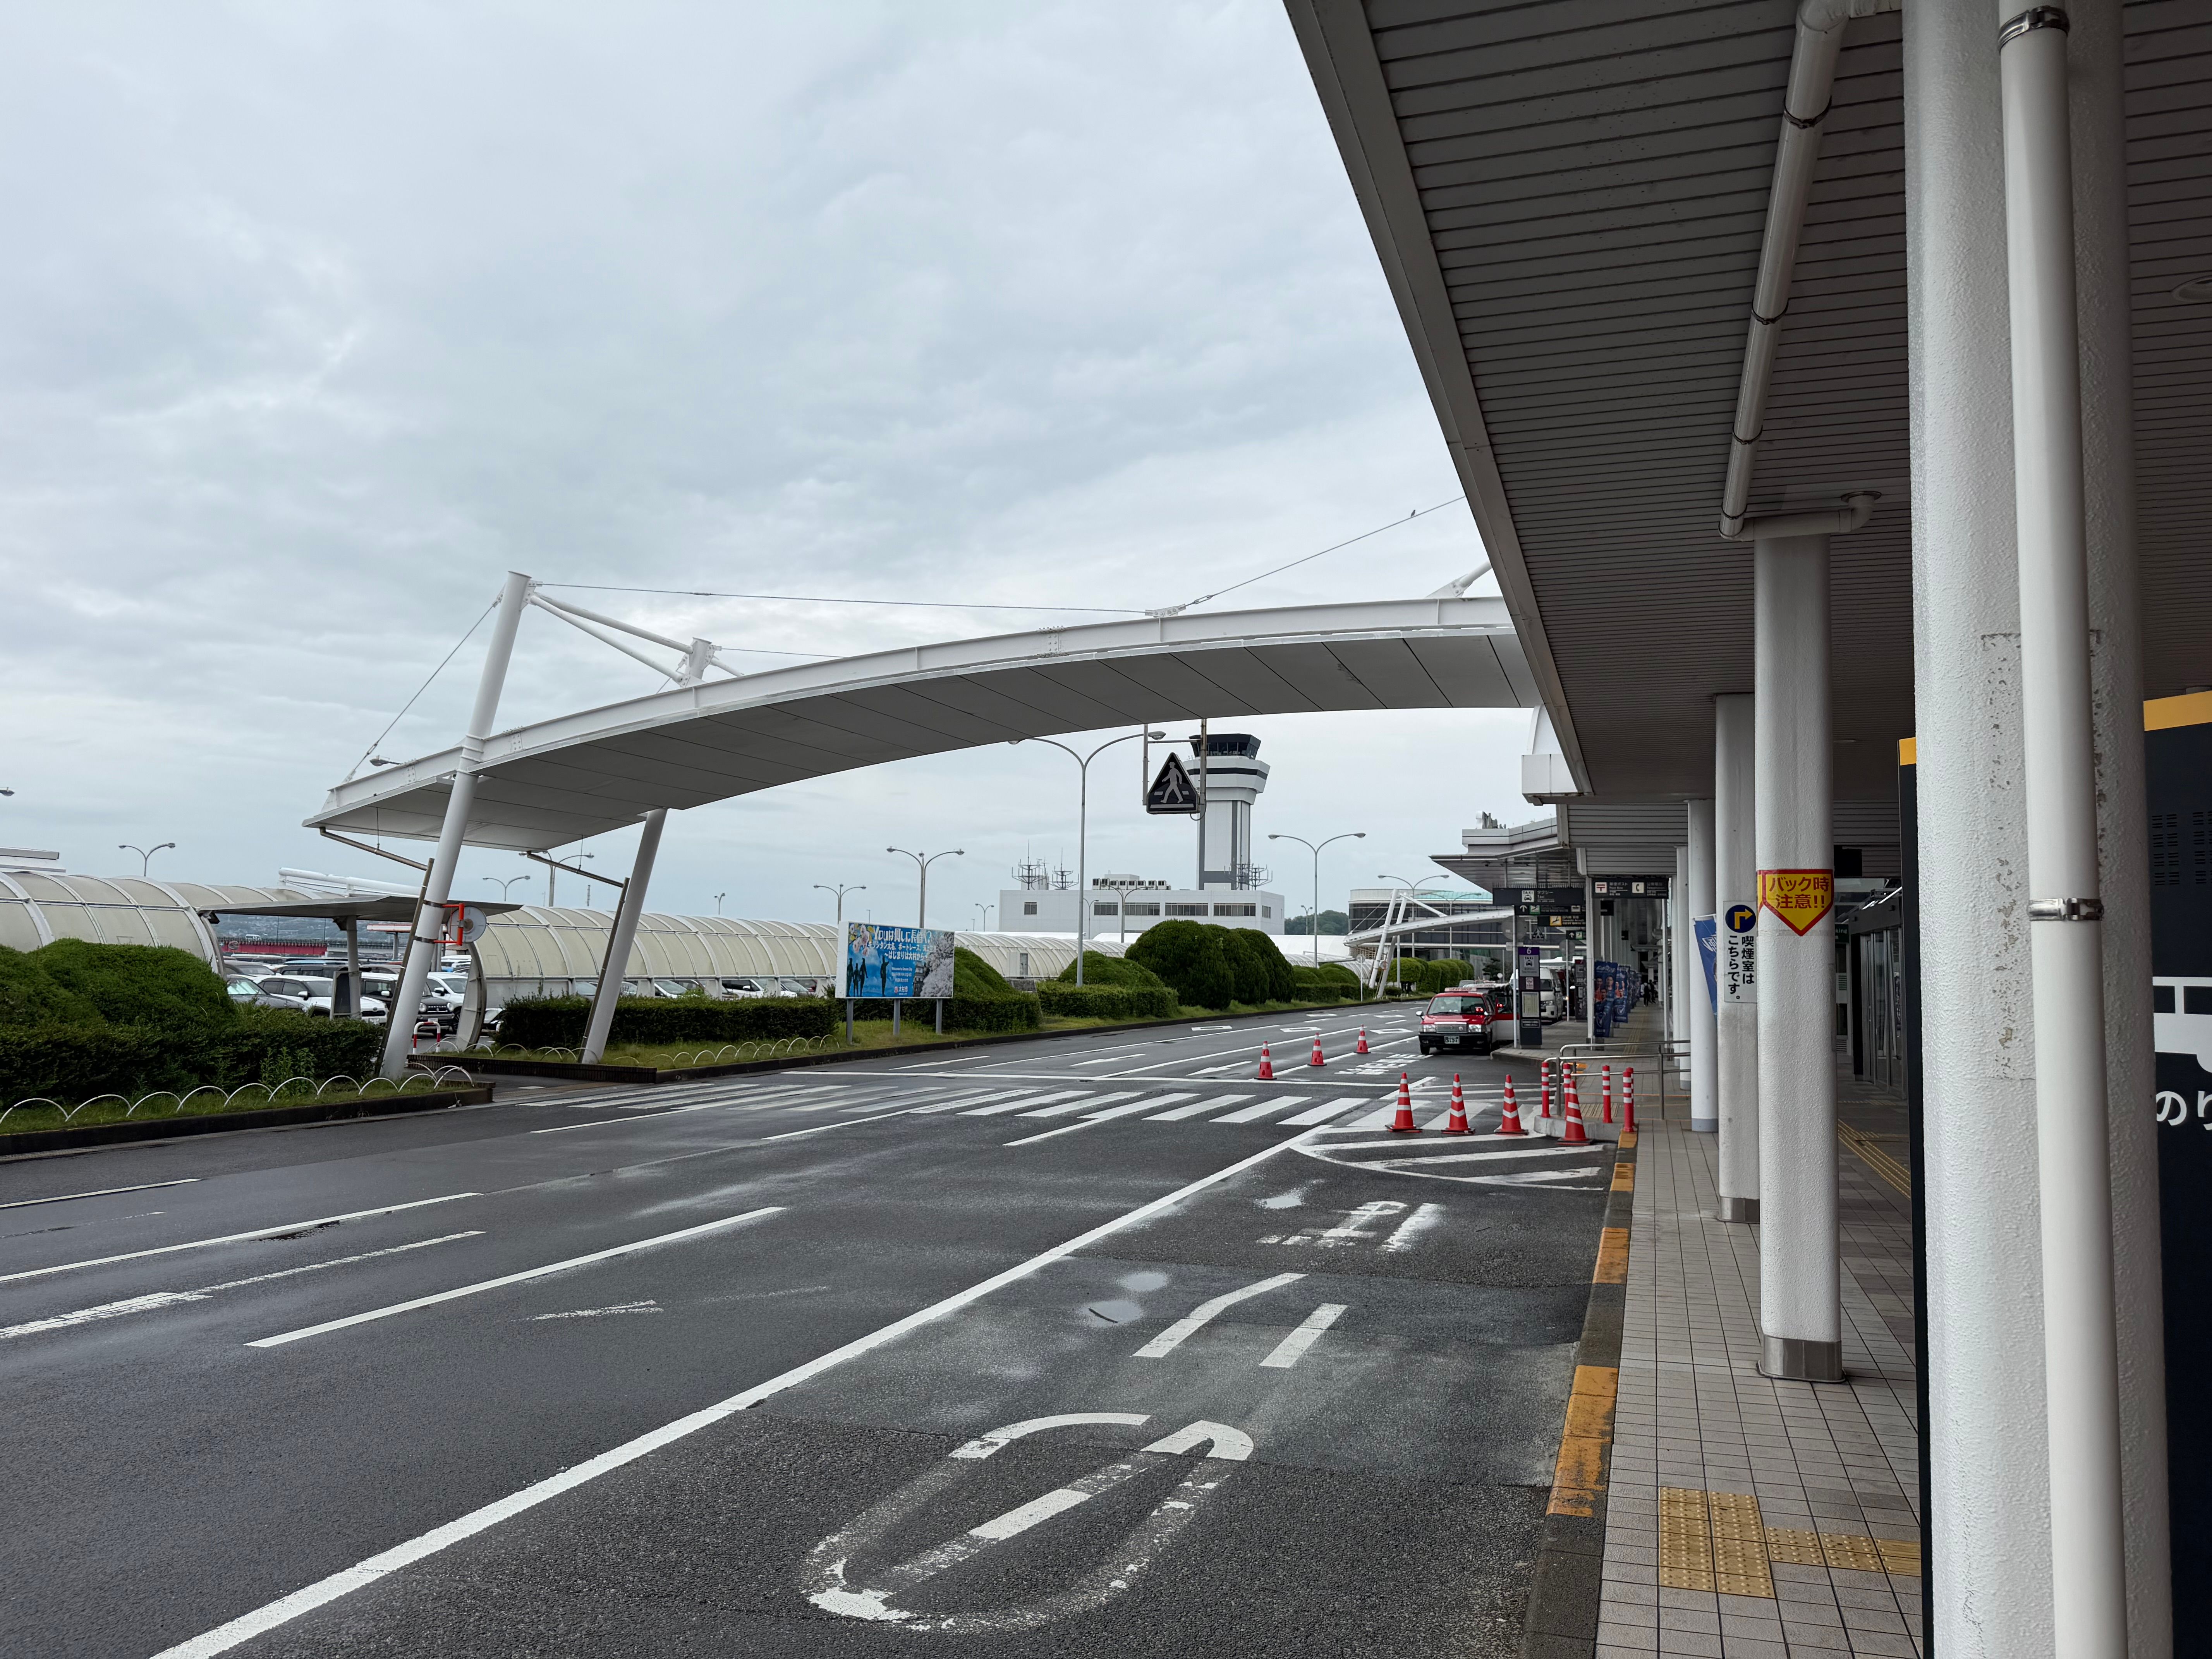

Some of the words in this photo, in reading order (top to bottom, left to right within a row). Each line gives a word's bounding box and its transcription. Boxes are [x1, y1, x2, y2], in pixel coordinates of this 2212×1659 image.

[1769, 876, 1829, 892] バック時
[1776, 894, 1824, 909] 注意!!
[1728, 935, 1740, 999] こちらです。
[1741, 936, 1755, 984] 喫煙室は
